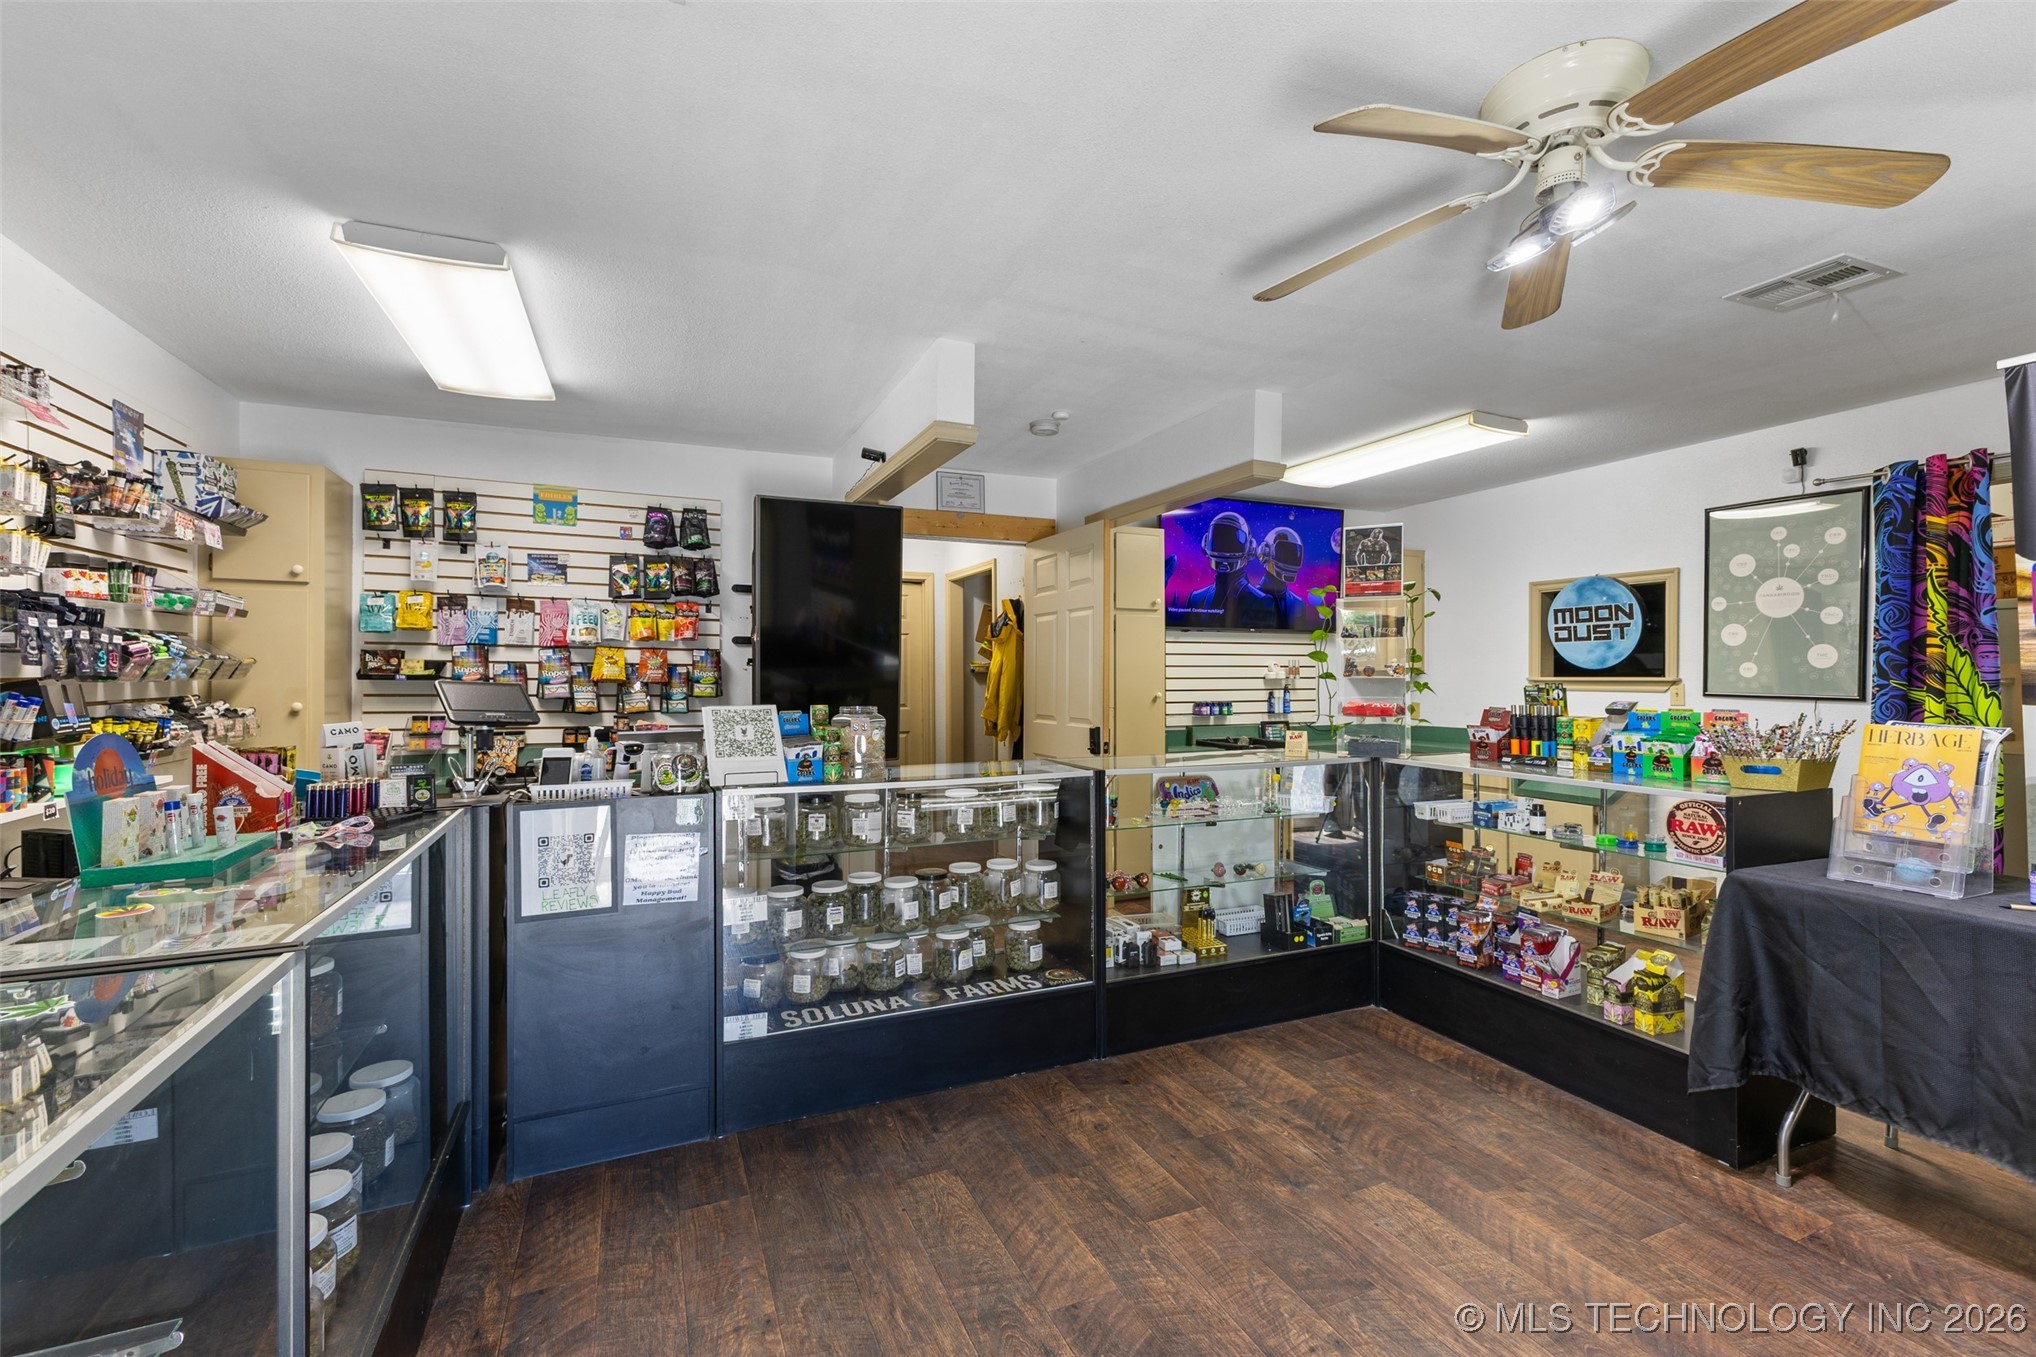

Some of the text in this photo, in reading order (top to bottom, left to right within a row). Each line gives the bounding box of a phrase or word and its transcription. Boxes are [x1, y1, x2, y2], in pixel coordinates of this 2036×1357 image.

[1553, 602, 1634, 625] MOON
[1554, 622, 1632, 643] DUST
[454, 666, 483, 675] Ropes
[542, 669, 569, 678] Ropes
[694, 669, 718, 679] Ropes
[573, 684, 597, 693] Ropes
[330, 726, 360, 736] CAMO
[1869, 728, 1973, 749] HERBAGE
[87, 766, 134, 792] holiday
[196, 764, 208, 788] FREE
[1679, 802, 1713, 815] OFFICIAL
[1683, 812, 1709, 821] NATURAL
[1670, 818, 1726, 838] RAW
[1669, 831, 1724, 854] AUTHENTIC RETAILER
[1427, 865, 1443, 874] OCB
[1589, 872, 1620, 883] RAW
[542, 886, 588, 900] LEAFLY
[636, 895, 687, 904] Management!
[641, 889, 666, 897] Happy
[541, 894, 599, 912] REVIEWS
[1569, 905, 1593, 915] RAW
[1641, 916, 1680, 929] RAW
[780, 974, 1042, 1028] SOLUNA FARMS
